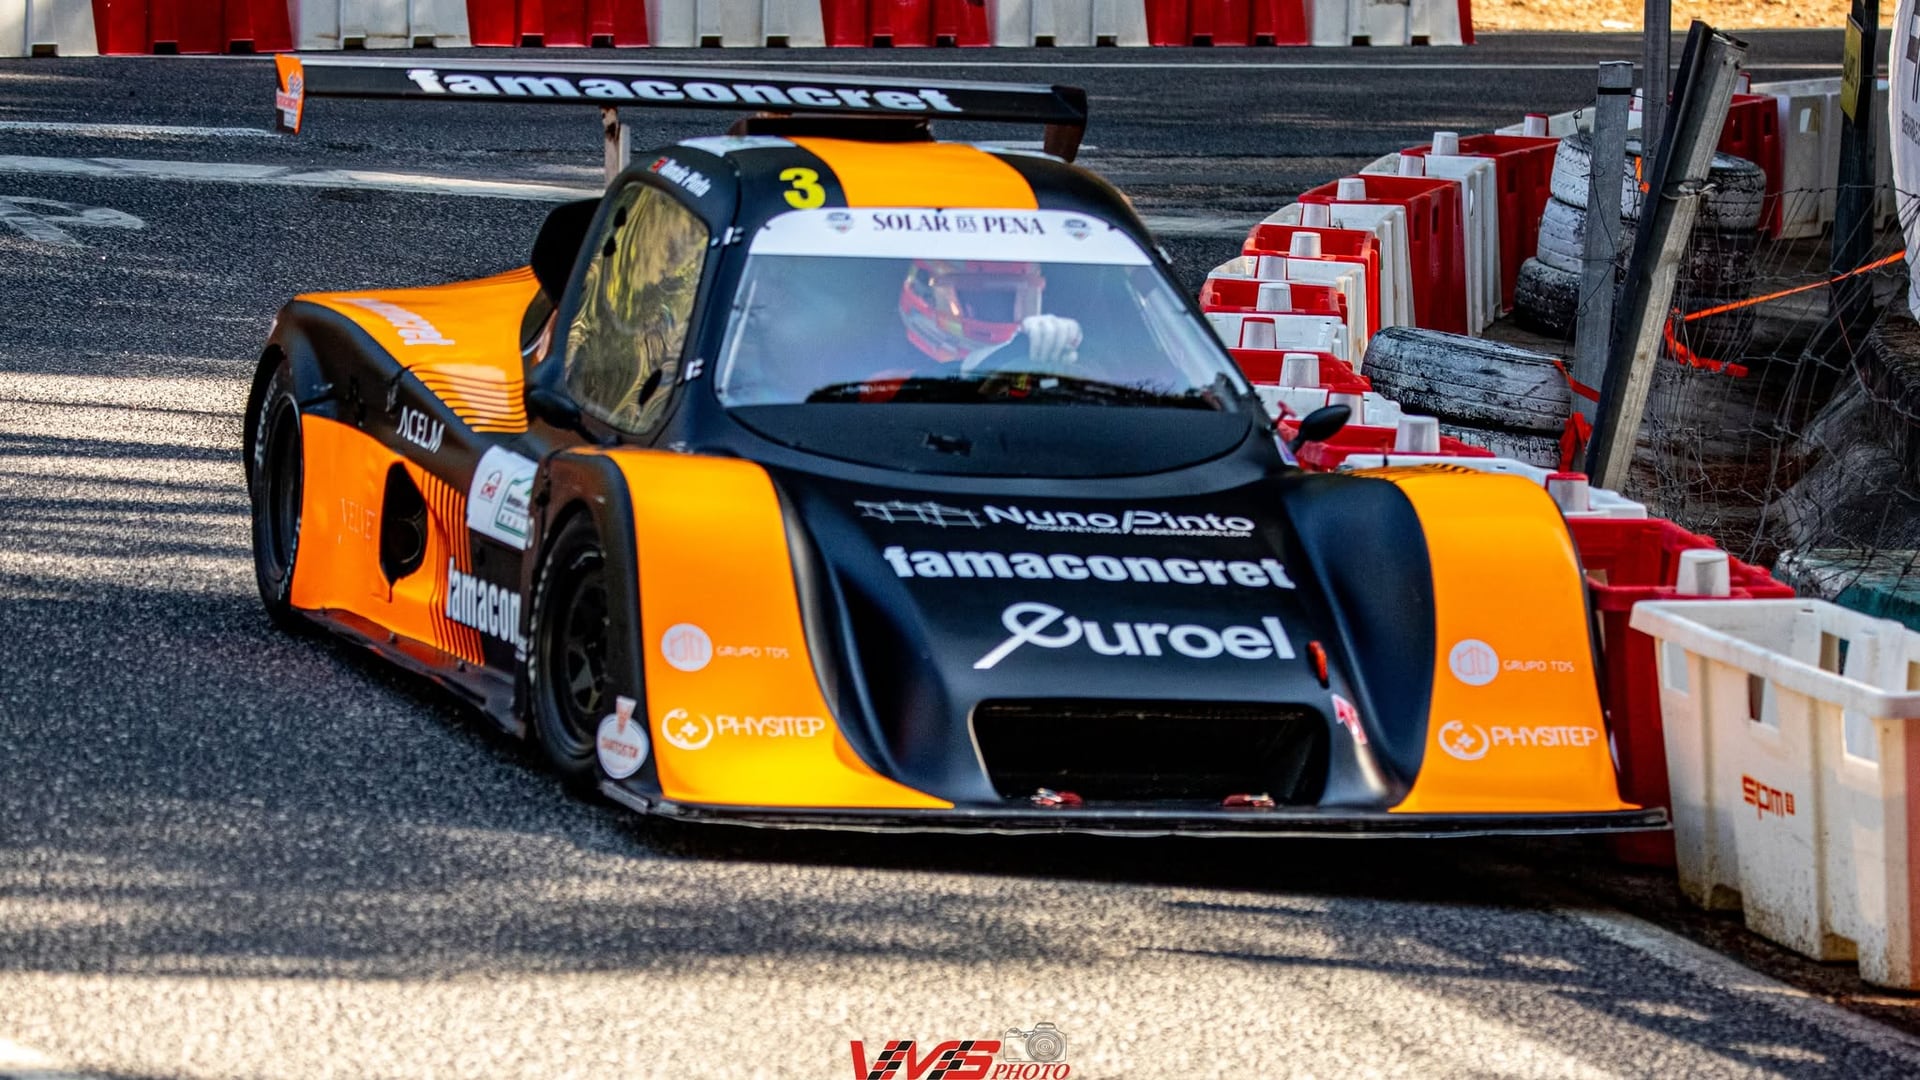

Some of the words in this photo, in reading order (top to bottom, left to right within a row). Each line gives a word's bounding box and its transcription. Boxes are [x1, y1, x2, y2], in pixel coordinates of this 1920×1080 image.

[407, 68, 963, 113] famaconcret
[778, 167, 827, 210] 3
[873, 213, 950, 232] SOLAR
[983, 215, 1046, 235] PENA
[396, 405, 446, 454] ACELM
[884, 546, 1297, 590] famaconcret
[716, 645, 762, 659] GRUPO
[766, 646, 790, 660] TDS
[1503, 659, 1547, 672] GRUPO
[1550, 660, 1575, 673] TDS
